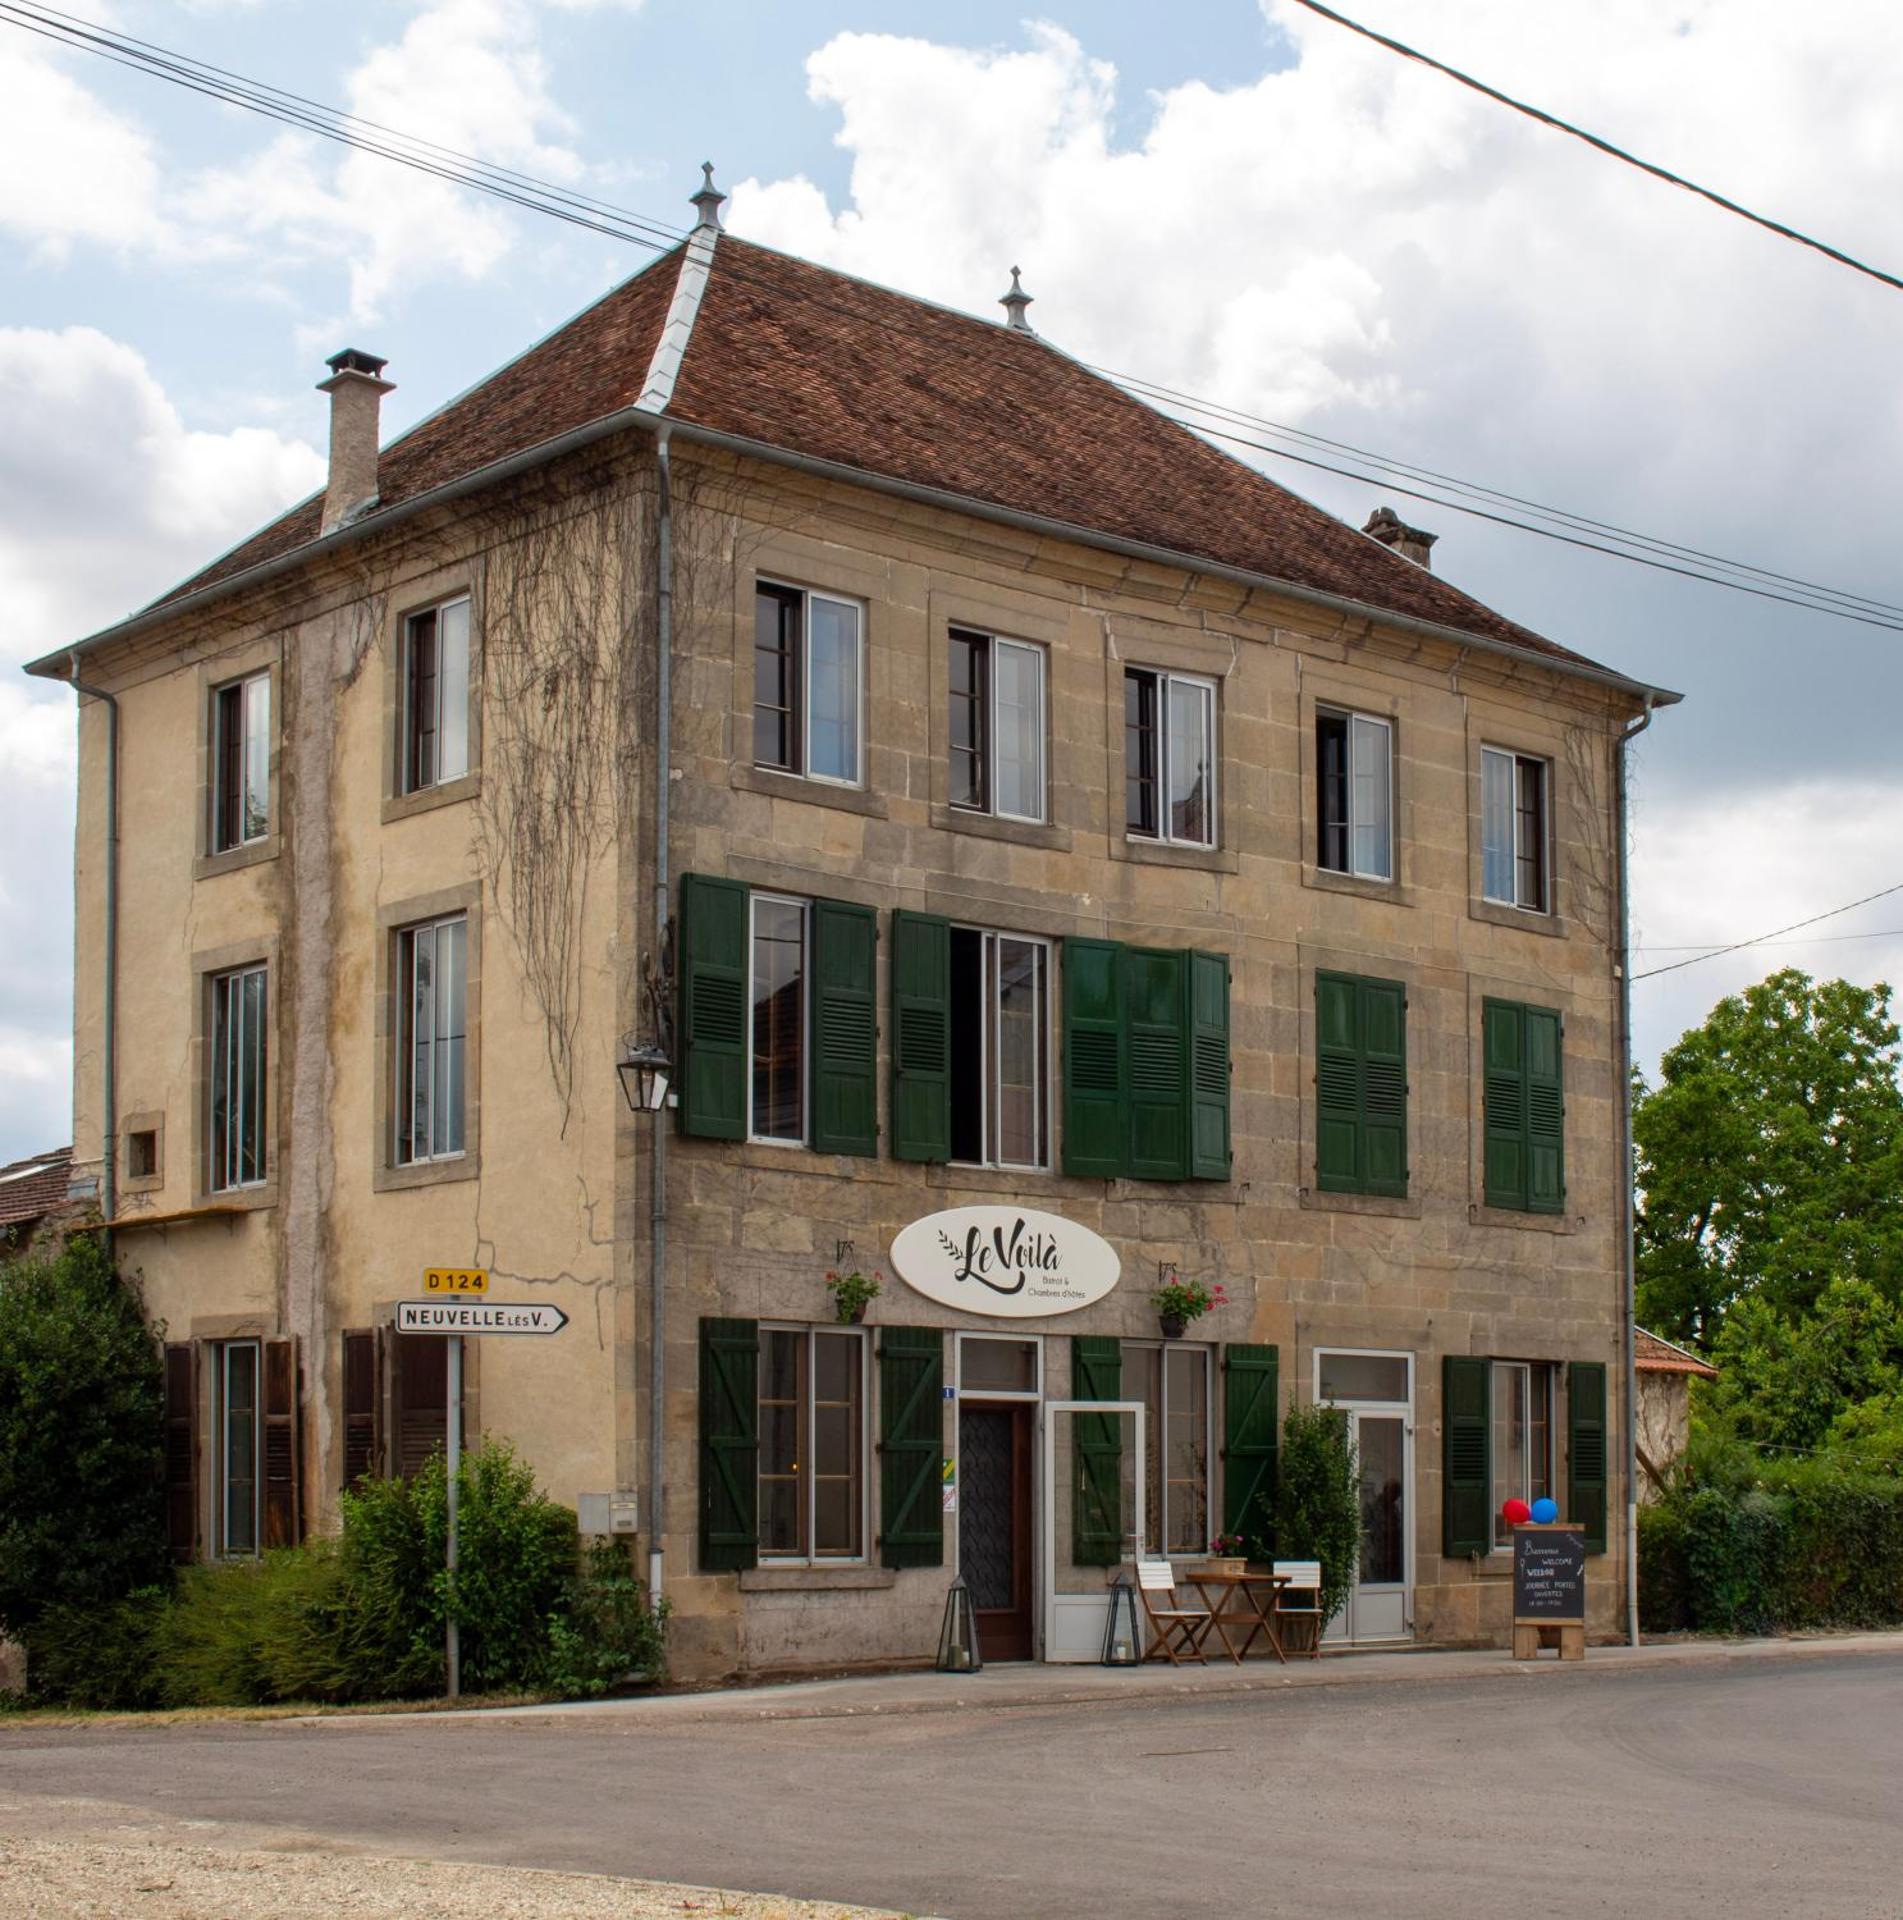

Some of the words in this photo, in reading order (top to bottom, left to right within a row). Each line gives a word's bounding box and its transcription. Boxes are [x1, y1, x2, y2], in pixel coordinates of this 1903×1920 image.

[994, 1218, 1062, 1270] Voilà
[429, 1274, 439, 1289] D
[447, 1274, 483, 1289] 124
[406, 1310, 505, 1326] NEUVELLE
[531, 1312, 548, 1327] V.
